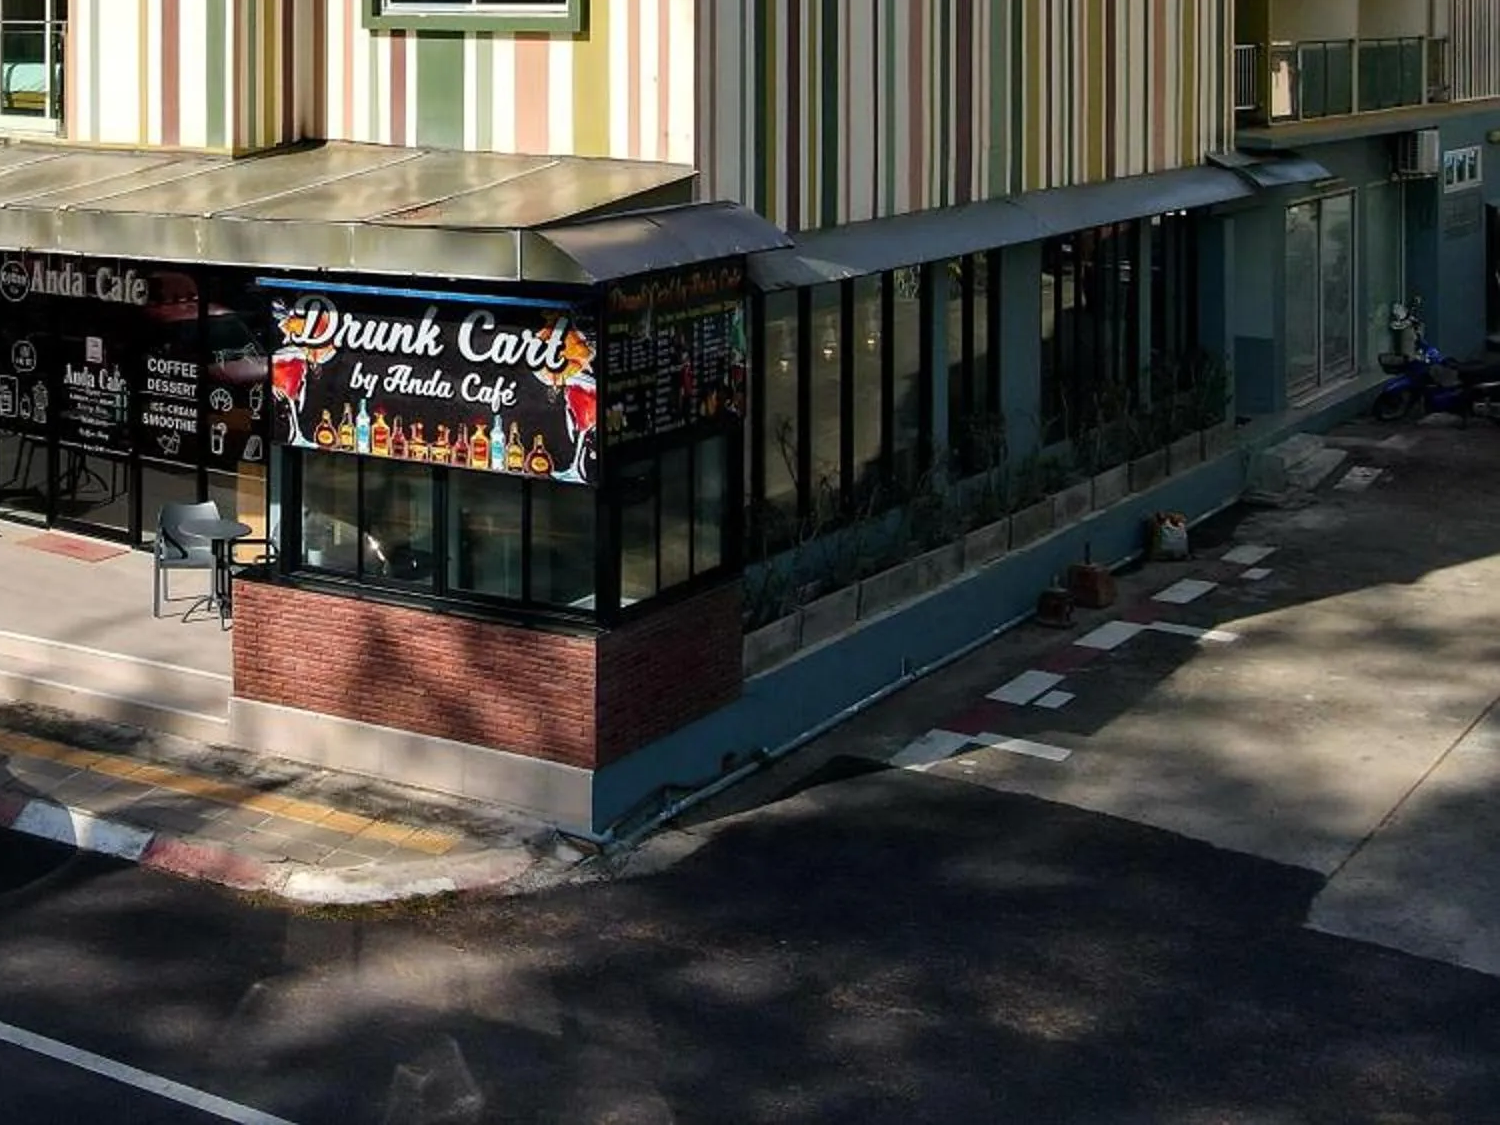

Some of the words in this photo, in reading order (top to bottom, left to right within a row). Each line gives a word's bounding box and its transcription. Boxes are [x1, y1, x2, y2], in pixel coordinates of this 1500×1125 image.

[30, 259, 88, 298] Anda
[96, 266, 150, 306] Cafe
[291, 294, 445, 356] Drunk
[457, 309, 570, 369] Cart
[147, 357, 198, 379] COFFEE
[147, 377, 197, 397] DESSERT
[349, 362, 379, 399] by
[383, 365, 454, 400] Anda
[460, 372, 518, 413] Café
[142, 412, 197, 434] SMOOTHIE
